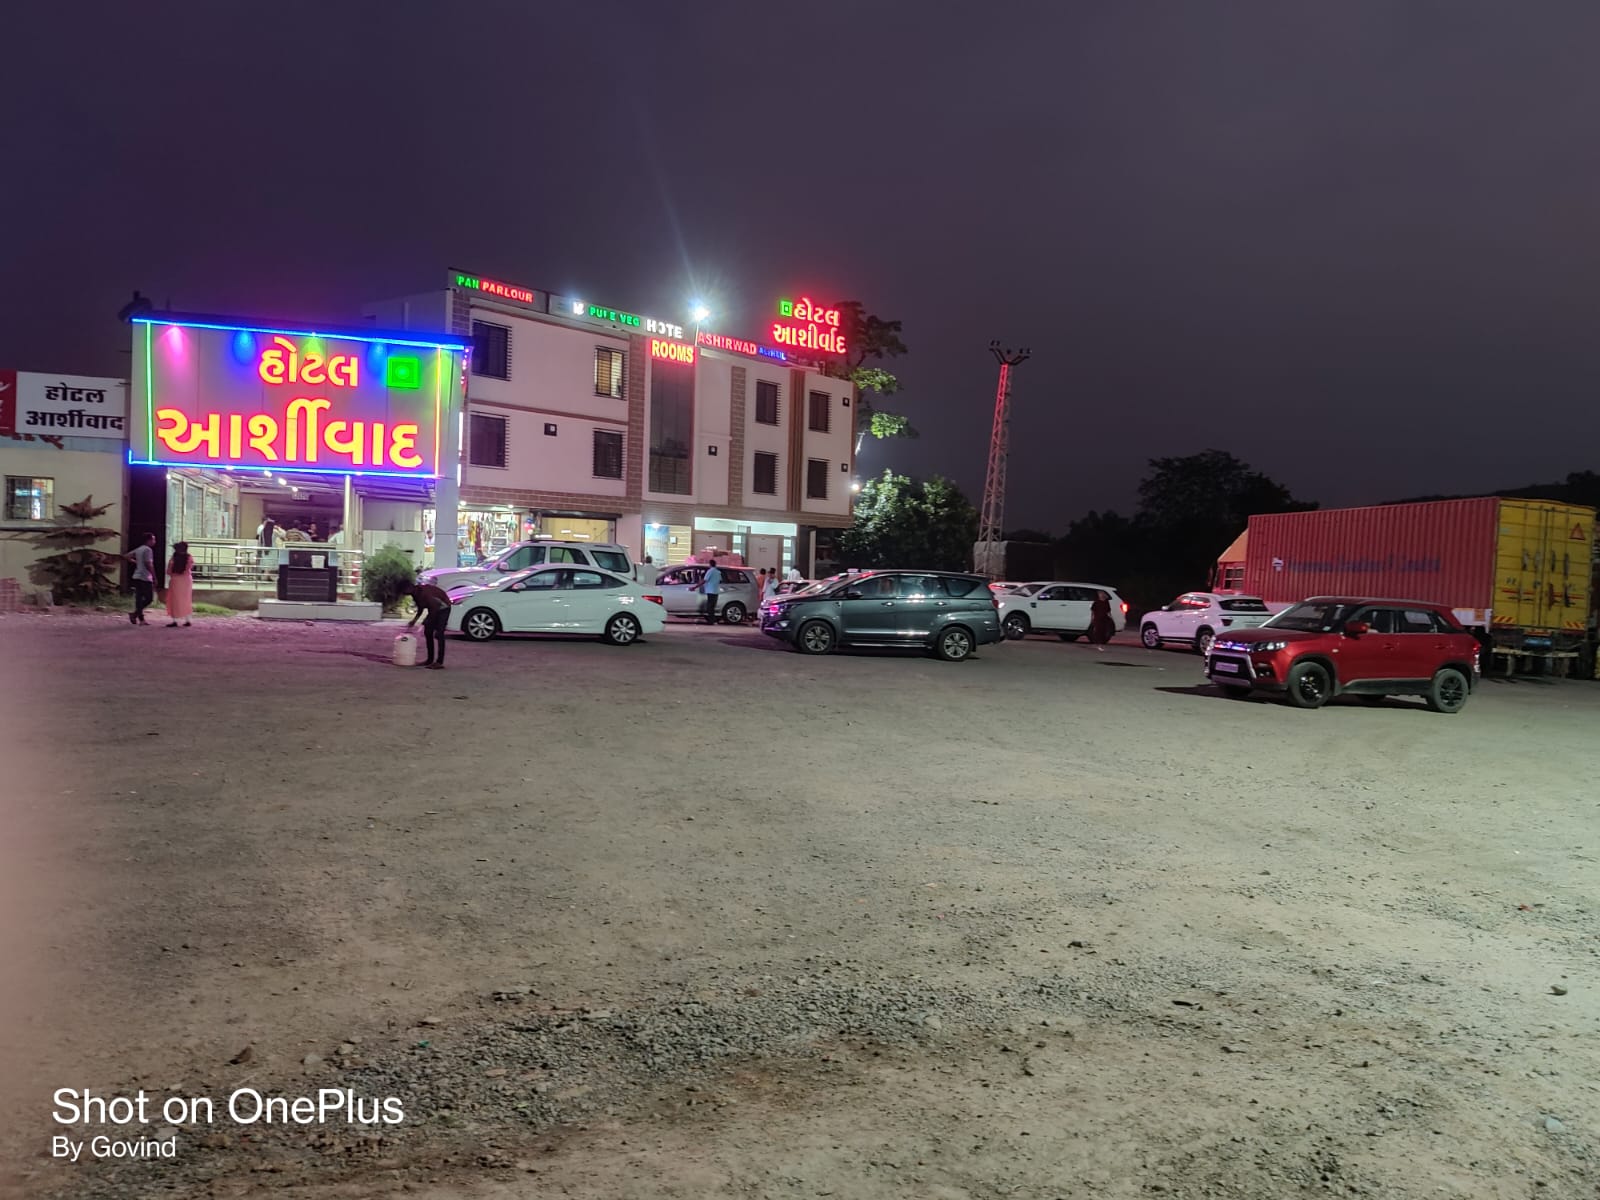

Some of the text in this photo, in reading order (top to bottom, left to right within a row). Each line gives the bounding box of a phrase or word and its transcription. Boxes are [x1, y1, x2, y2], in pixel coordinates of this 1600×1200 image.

[456, 275, 533, 303] PAN PARLOUR
[793, 297, 840, 327] હોટલ
[619, 313, 641, 327] VEG
[697, 332, 757, 355] ASHIRWAD
[773, 323, 847, 354] આશીર્વાદ
[258, 336, 360, 387] હોટલ
[651, 339, 694, 364] ROOMS
[44, 382, 107, 403] होटल
